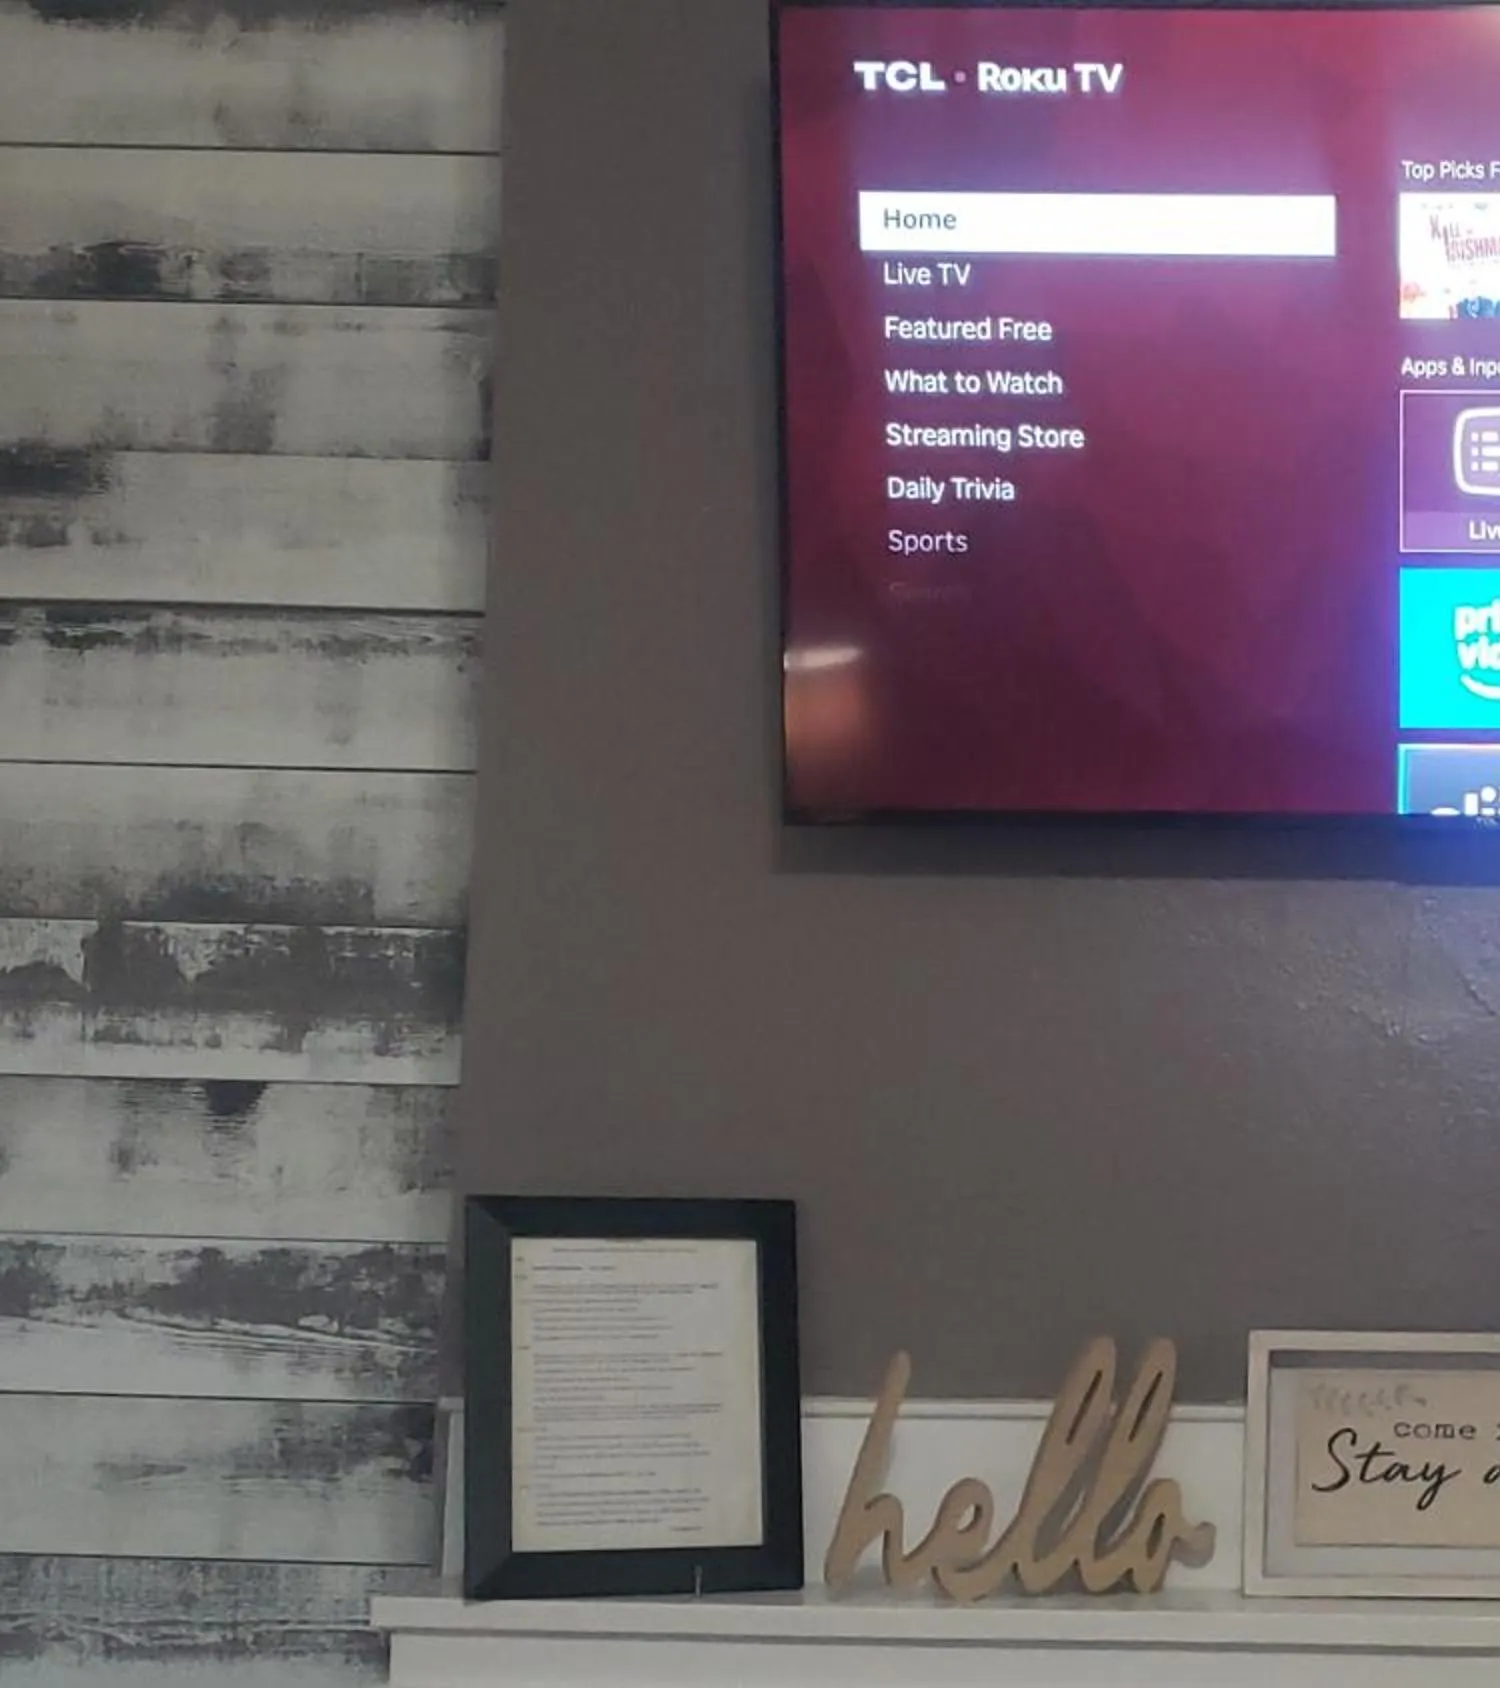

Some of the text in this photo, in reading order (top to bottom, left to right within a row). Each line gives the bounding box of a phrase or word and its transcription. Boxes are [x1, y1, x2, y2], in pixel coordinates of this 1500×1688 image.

[853, 61, 1124, 93] TCL Roku TV
[1401, 160, 1435, 182] Top
[1439, 160, 1485, 179] Picks
[883, 208, 957, 230] Home
[883, 261, 971, 286] Live TV
[884, 316, 1053, 341] Featured Free
[1401, 357, 1447, 379] Apps
[1451, 357, 1465, 376] &
[884, 369, 1063, 394] What to Watch
[886, 422, 1085, 453] Streaming Store
[887, 476, 1015, 504] Daily Trivia
[888, 529, 969, 556] Sports
[1393, 1420, 1477, 1441] come
[825, 1335, 1216, 1601] hello
[1311, 1428, 1461, 1511] Stay
